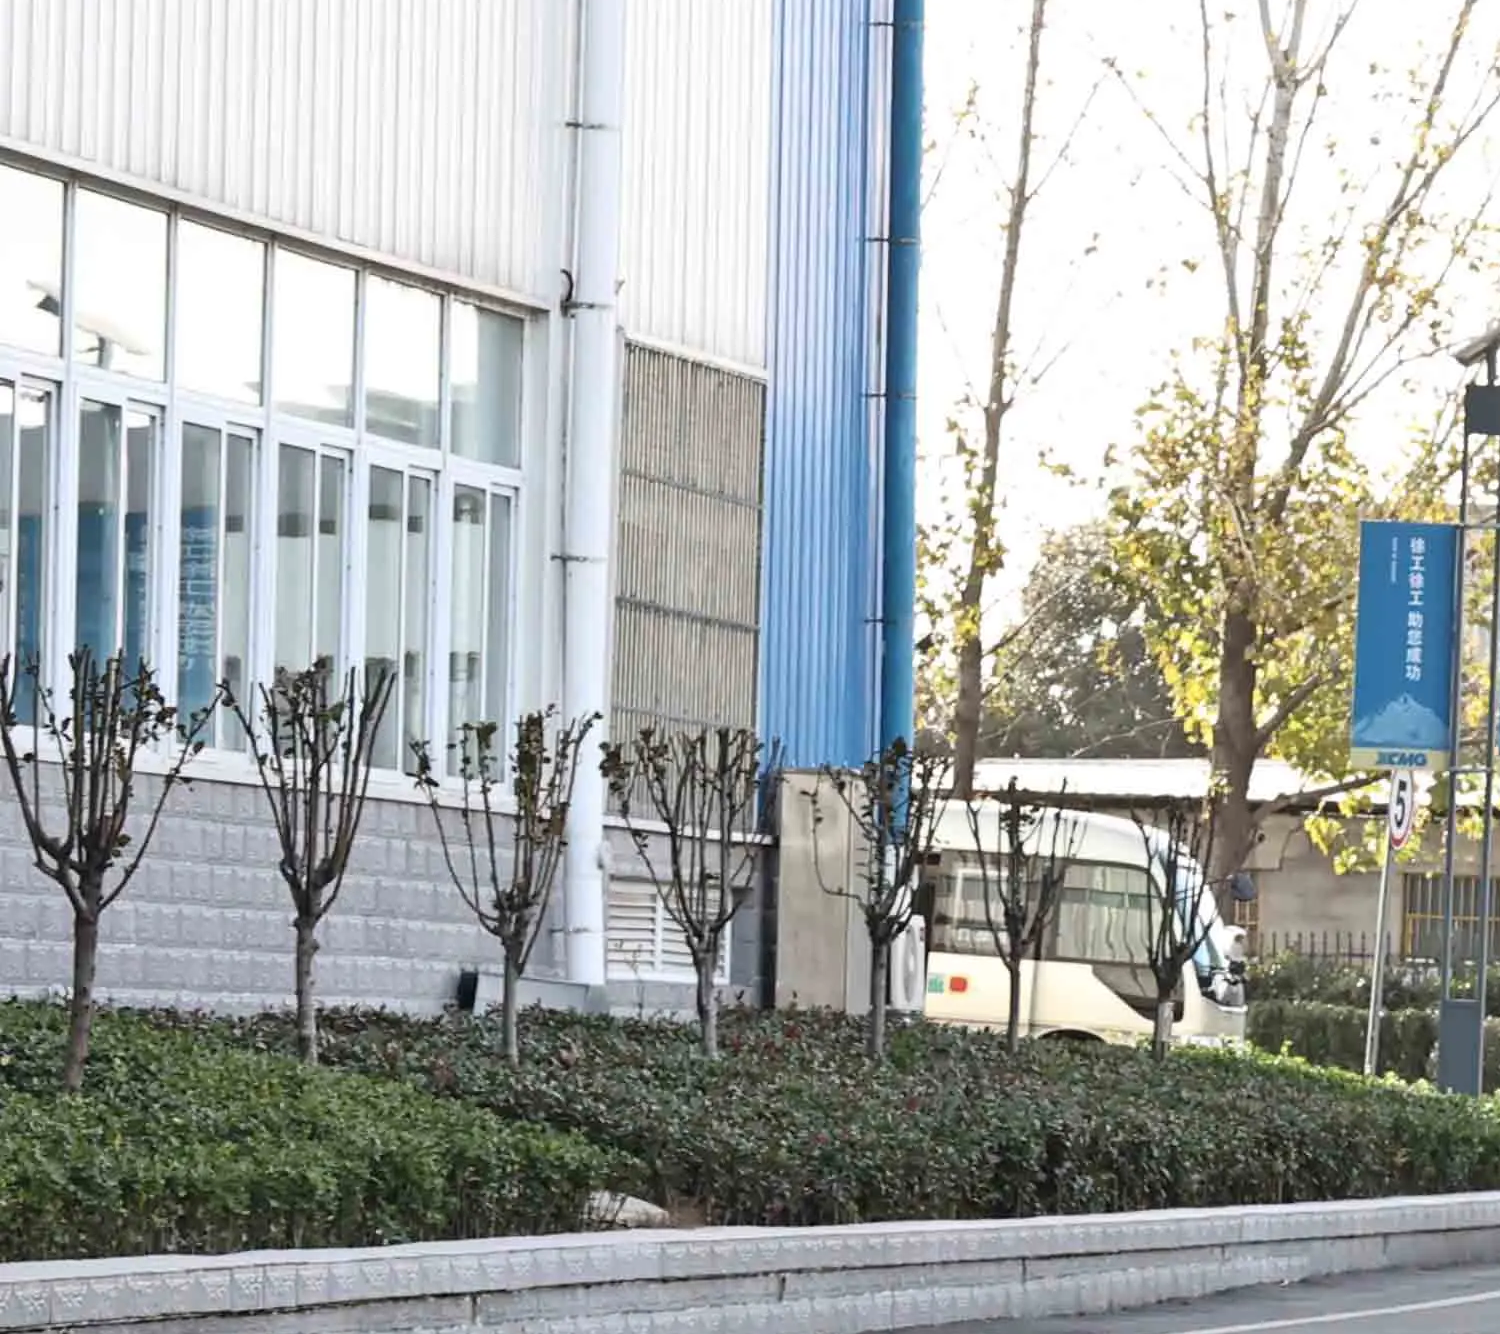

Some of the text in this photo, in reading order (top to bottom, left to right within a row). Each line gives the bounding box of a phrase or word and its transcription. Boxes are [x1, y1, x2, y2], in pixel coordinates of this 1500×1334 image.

[1405, 537, 1426, 682] 徐工徐工 助您成功
[1375, 751, 1428, 767] XCMG
[1394, 778, 1408, 829] 5
